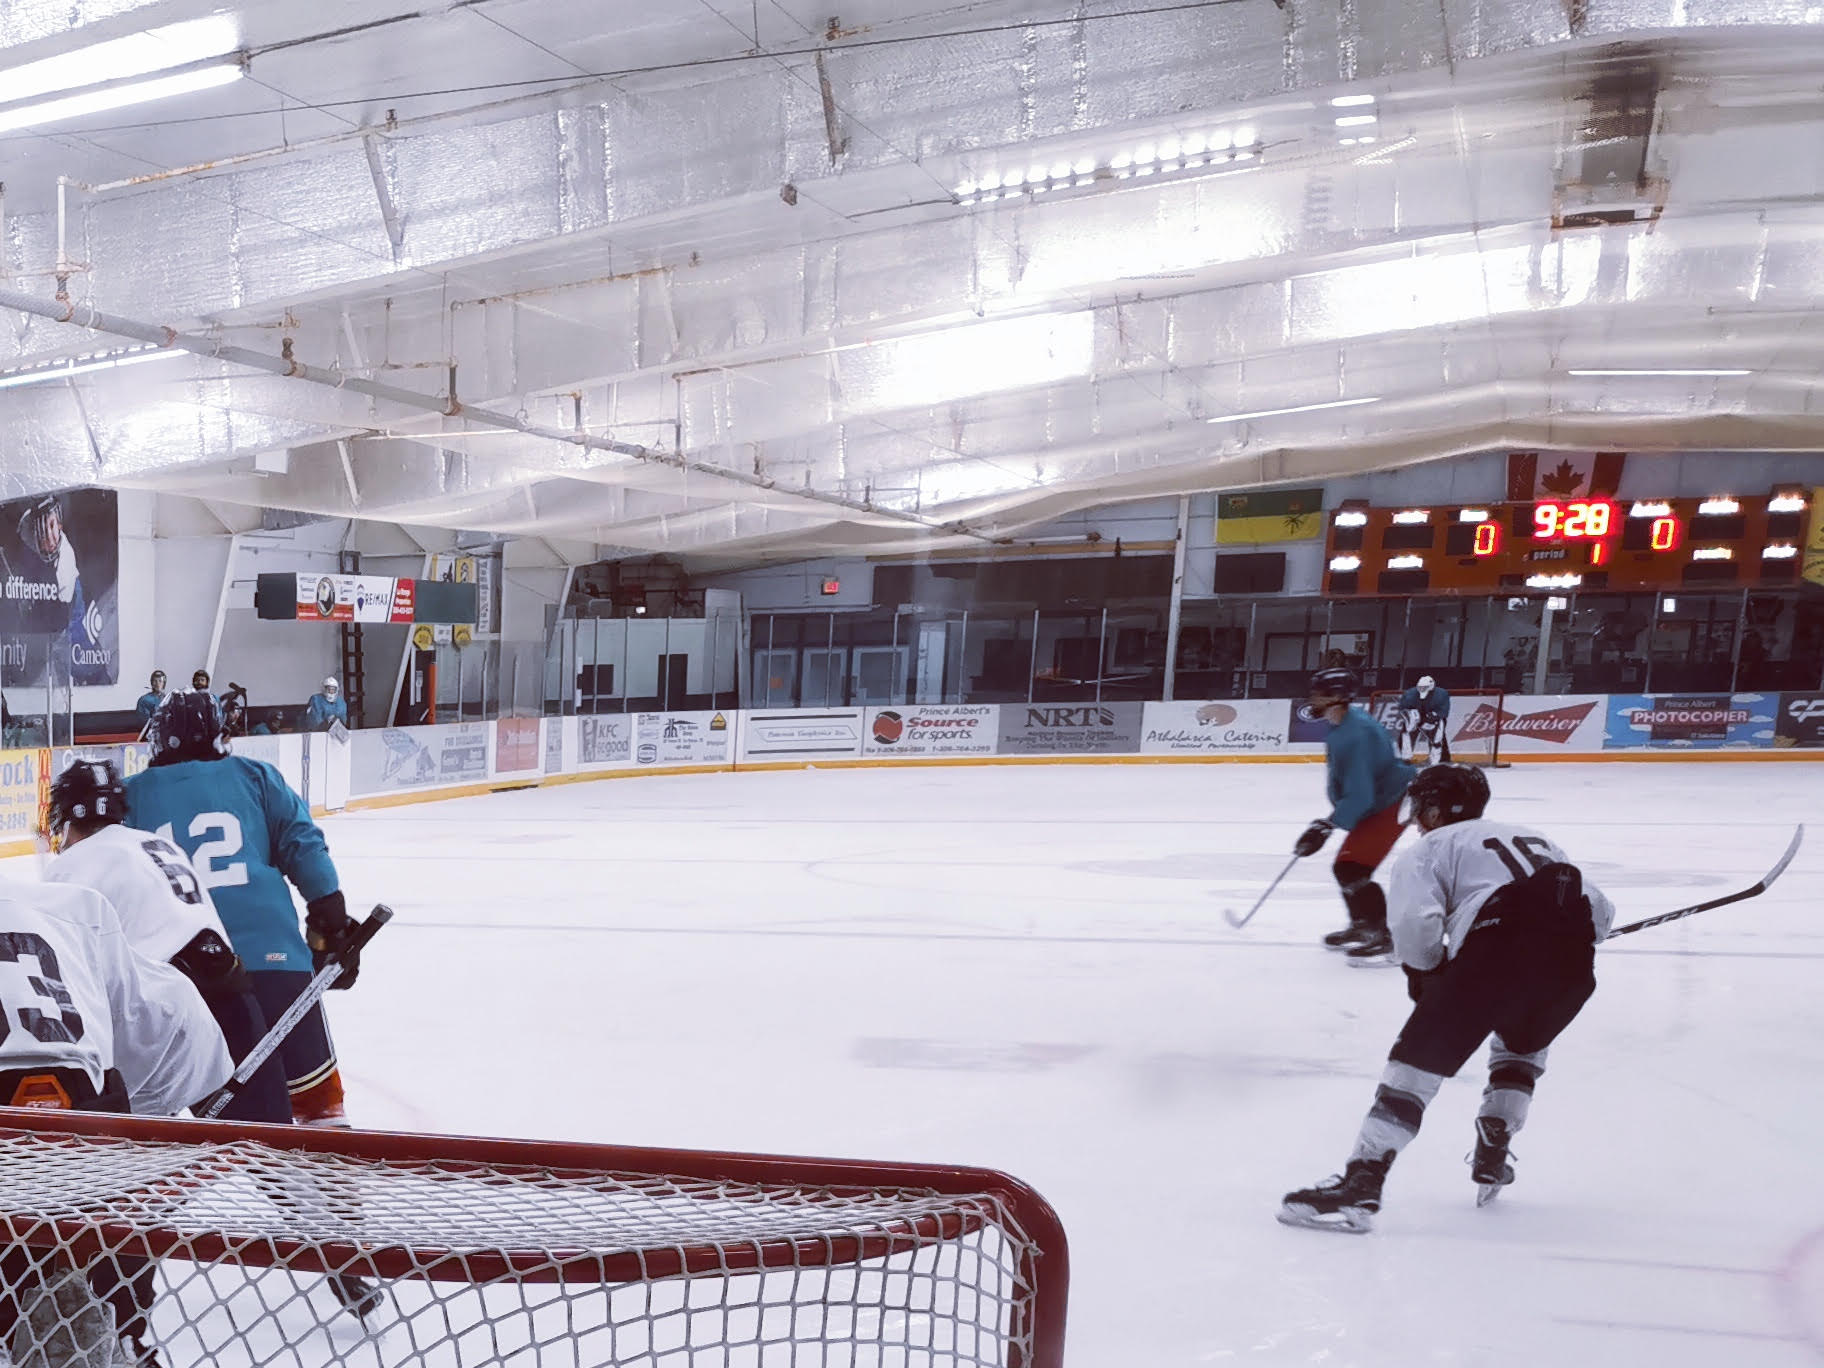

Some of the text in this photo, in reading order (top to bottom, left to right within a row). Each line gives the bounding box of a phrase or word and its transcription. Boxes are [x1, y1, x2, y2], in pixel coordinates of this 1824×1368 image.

[1534, 503, 1610, 537] 9:28
[1474, 524, 1496, 555] 0
[1652, 519, 1675, 549] 0
[1592, 543, 1601, 564] 1
[6, 576, 58, 600] difference
[72, 644, 111, 664] Cameco
[919, 707, 991, 716] Prince Albert's
[1633, 710, 1749, 723] PHOTOCOPIER
[598, 724, 618, 738] KFC
[906, 717, 979, 729] Source
[907, 728, 973, 743] for sports
[1146, 730, 1212, 742] Athabasca
[1223, 730, 1282, 746] Catering
